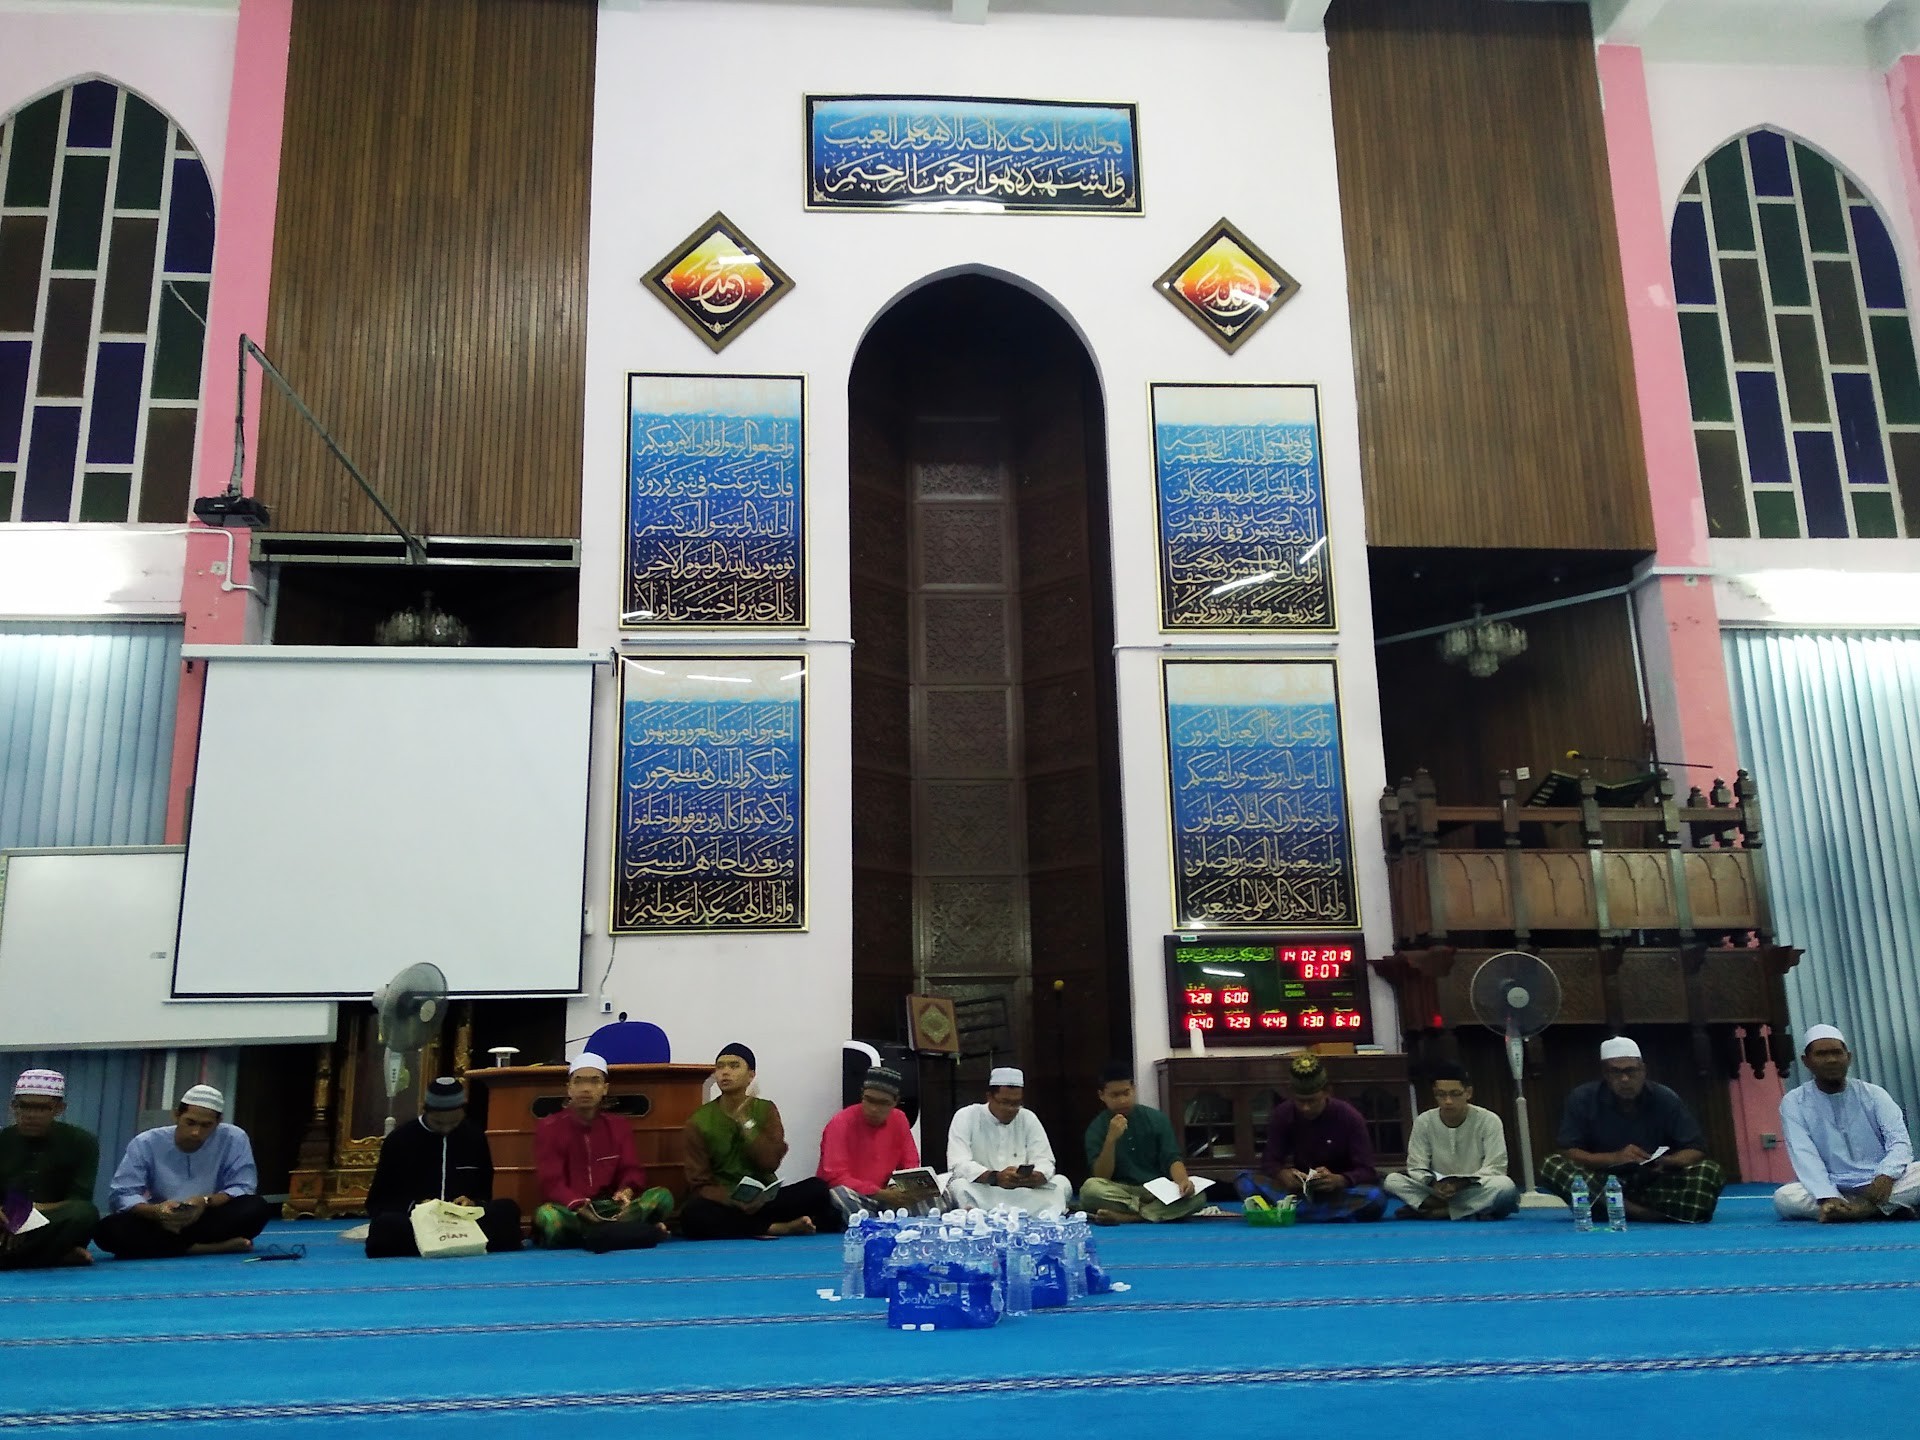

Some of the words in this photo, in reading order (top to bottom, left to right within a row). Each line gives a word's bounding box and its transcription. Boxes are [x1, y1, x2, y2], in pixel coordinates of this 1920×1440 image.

[1284, 951, 1295, 961] 14
[1301, 951, 1316, 961] 02
[1322, 950, 1351, 961] 2019
[1304, 964, 1340, 979] 8:07
[1188, 992, 1212, 1004] 7:28
[1224, 992, 1249, 1003] 6:00
[1188, 1017, 1213, 1028] 8:40
[1226, 1017, 1251, 1028] 7:29
[1262, 1016, 1287, 1027] 4:49
[1303, 1015, 1324, 1027] 1:30
[1335, 1015, 1360, 1027] 6:10
